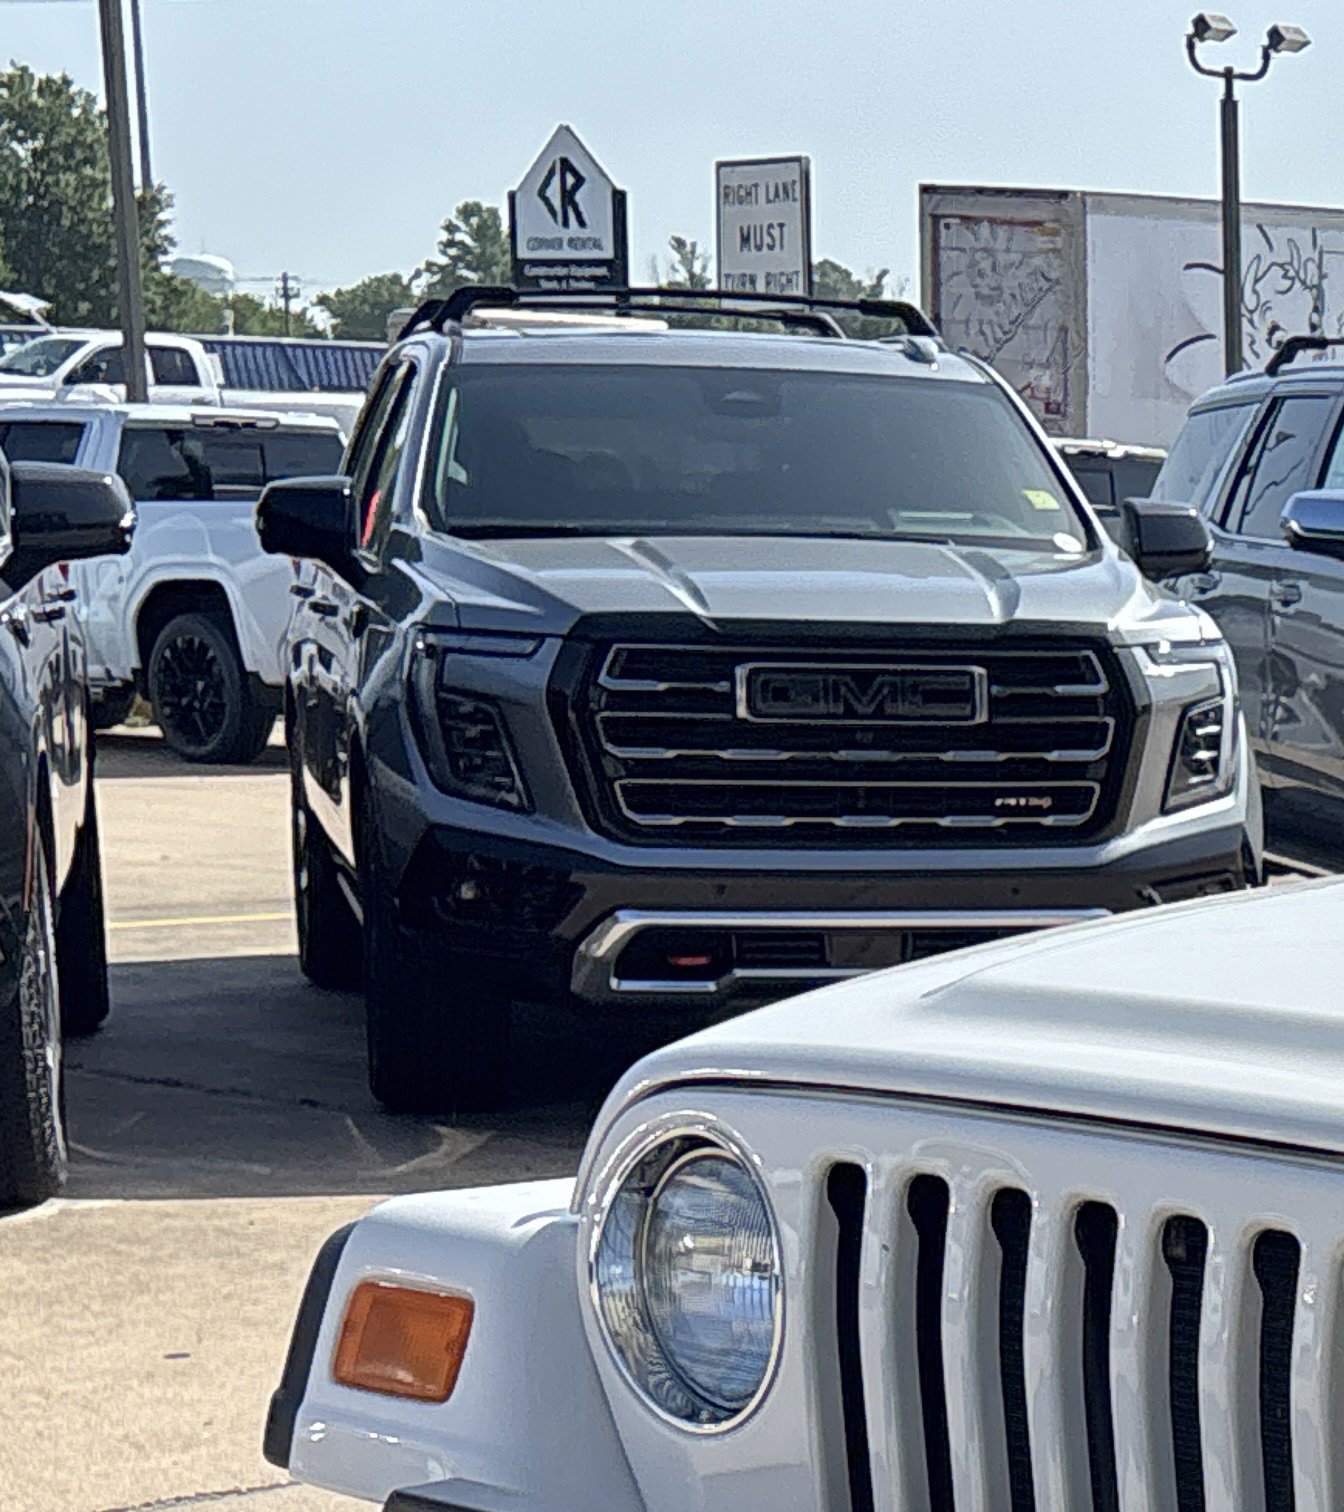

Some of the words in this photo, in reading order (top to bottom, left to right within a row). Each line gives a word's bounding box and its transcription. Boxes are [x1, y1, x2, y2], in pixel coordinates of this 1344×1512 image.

[723, 182, 759, 205] RIGHT
[765, 179, 798, 204] LANE
[739, 222, 786, 252] MUST
[752, 671, 974, 718] GMC
